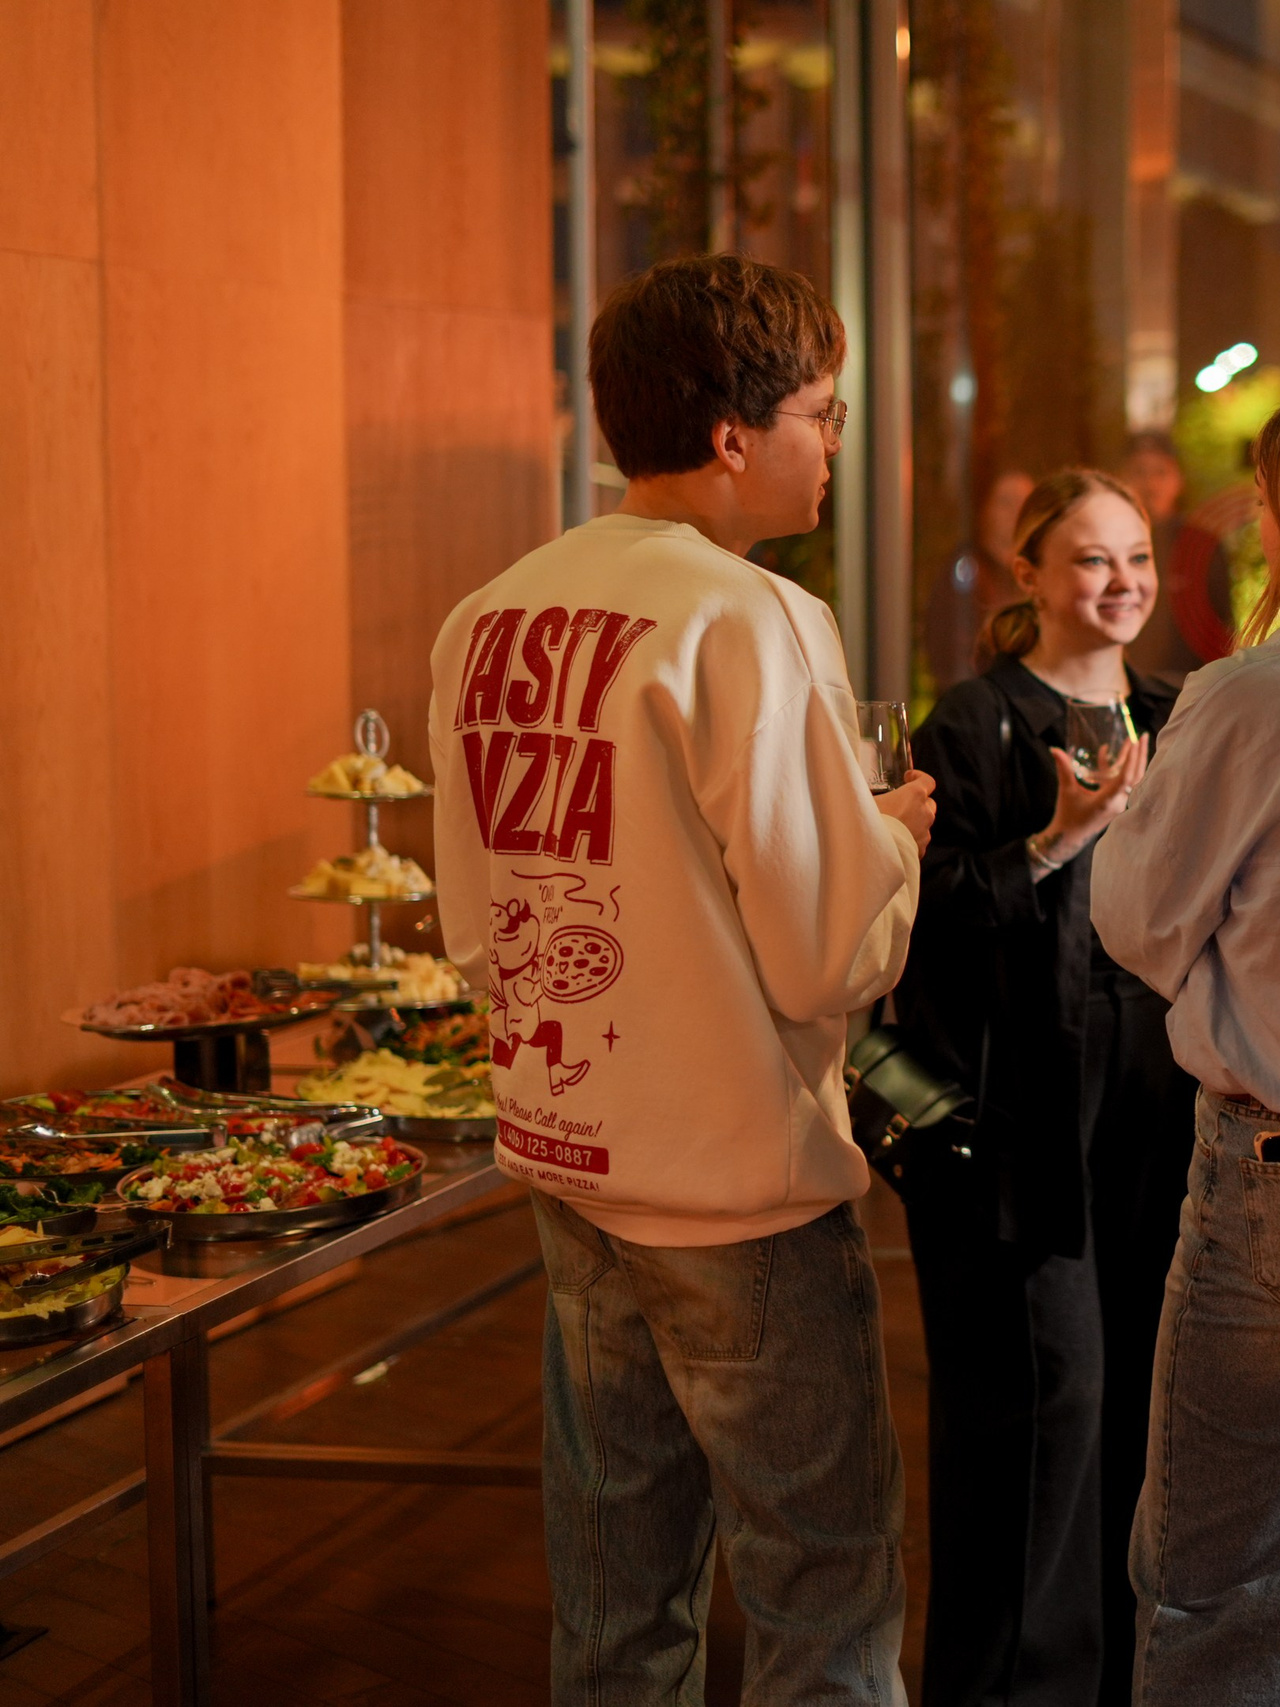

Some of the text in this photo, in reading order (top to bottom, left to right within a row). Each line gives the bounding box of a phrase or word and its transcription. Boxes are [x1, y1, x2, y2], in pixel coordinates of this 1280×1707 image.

[509, 1098, 532, 1123] Please
[535, 1107, 558, 1129] Call
[558, 1119, 603, 1141] again!
[527, 1136, 592, 1167] 125-0887
[519, 1164, 534, 1178] EAT
[537, 1169, 565, 1185] MORE
[566, 1176, 600, 1192] PIZZA!
